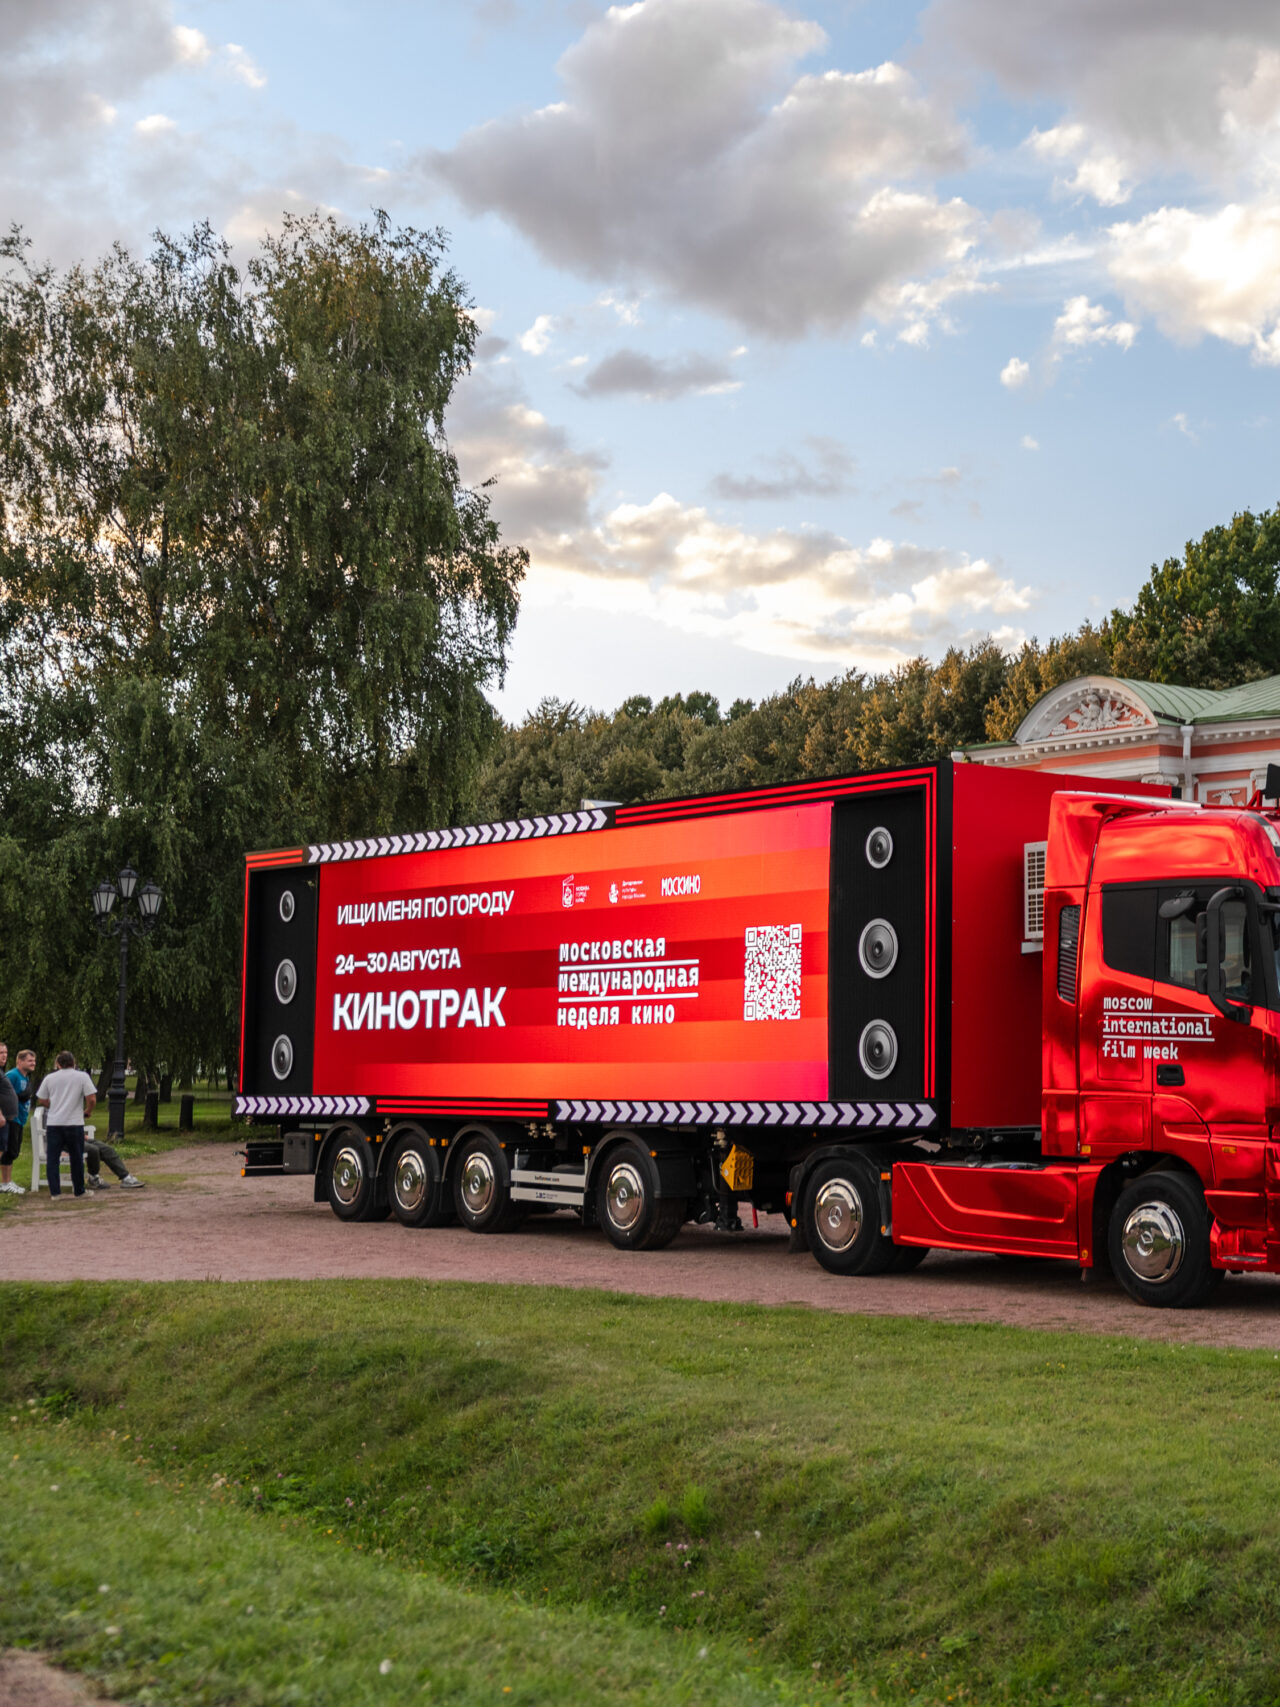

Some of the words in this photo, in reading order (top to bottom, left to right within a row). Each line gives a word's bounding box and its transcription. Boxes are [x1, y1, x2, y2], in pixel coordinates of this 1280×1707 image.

[661, 874, 701, 897] МОСКИНО
[337, 902, 376, 927] ИЩИ
[377, 898, 422, 922] МЕНЯ
[424, 896, 448, 919] ПО
[449, 890, 515, 917] ГОРОДУ
[388, 947, 462, 972] АВГУСТА
[559, 937, 666, 963] московская
[558, 966, 699, 997] международная
[332, 986, 508, 1031] КИНОТРАК
[1103, 996, 1153, 1011] moscow
[557, 1006, 620, 1030] неделя
[631, 1003, 676, 1025] кино
[1102, 1015, 1213, 1036] international
[1102, 1040, 1136, 1059] film
[1143, 1042, 1179, 1060] week
